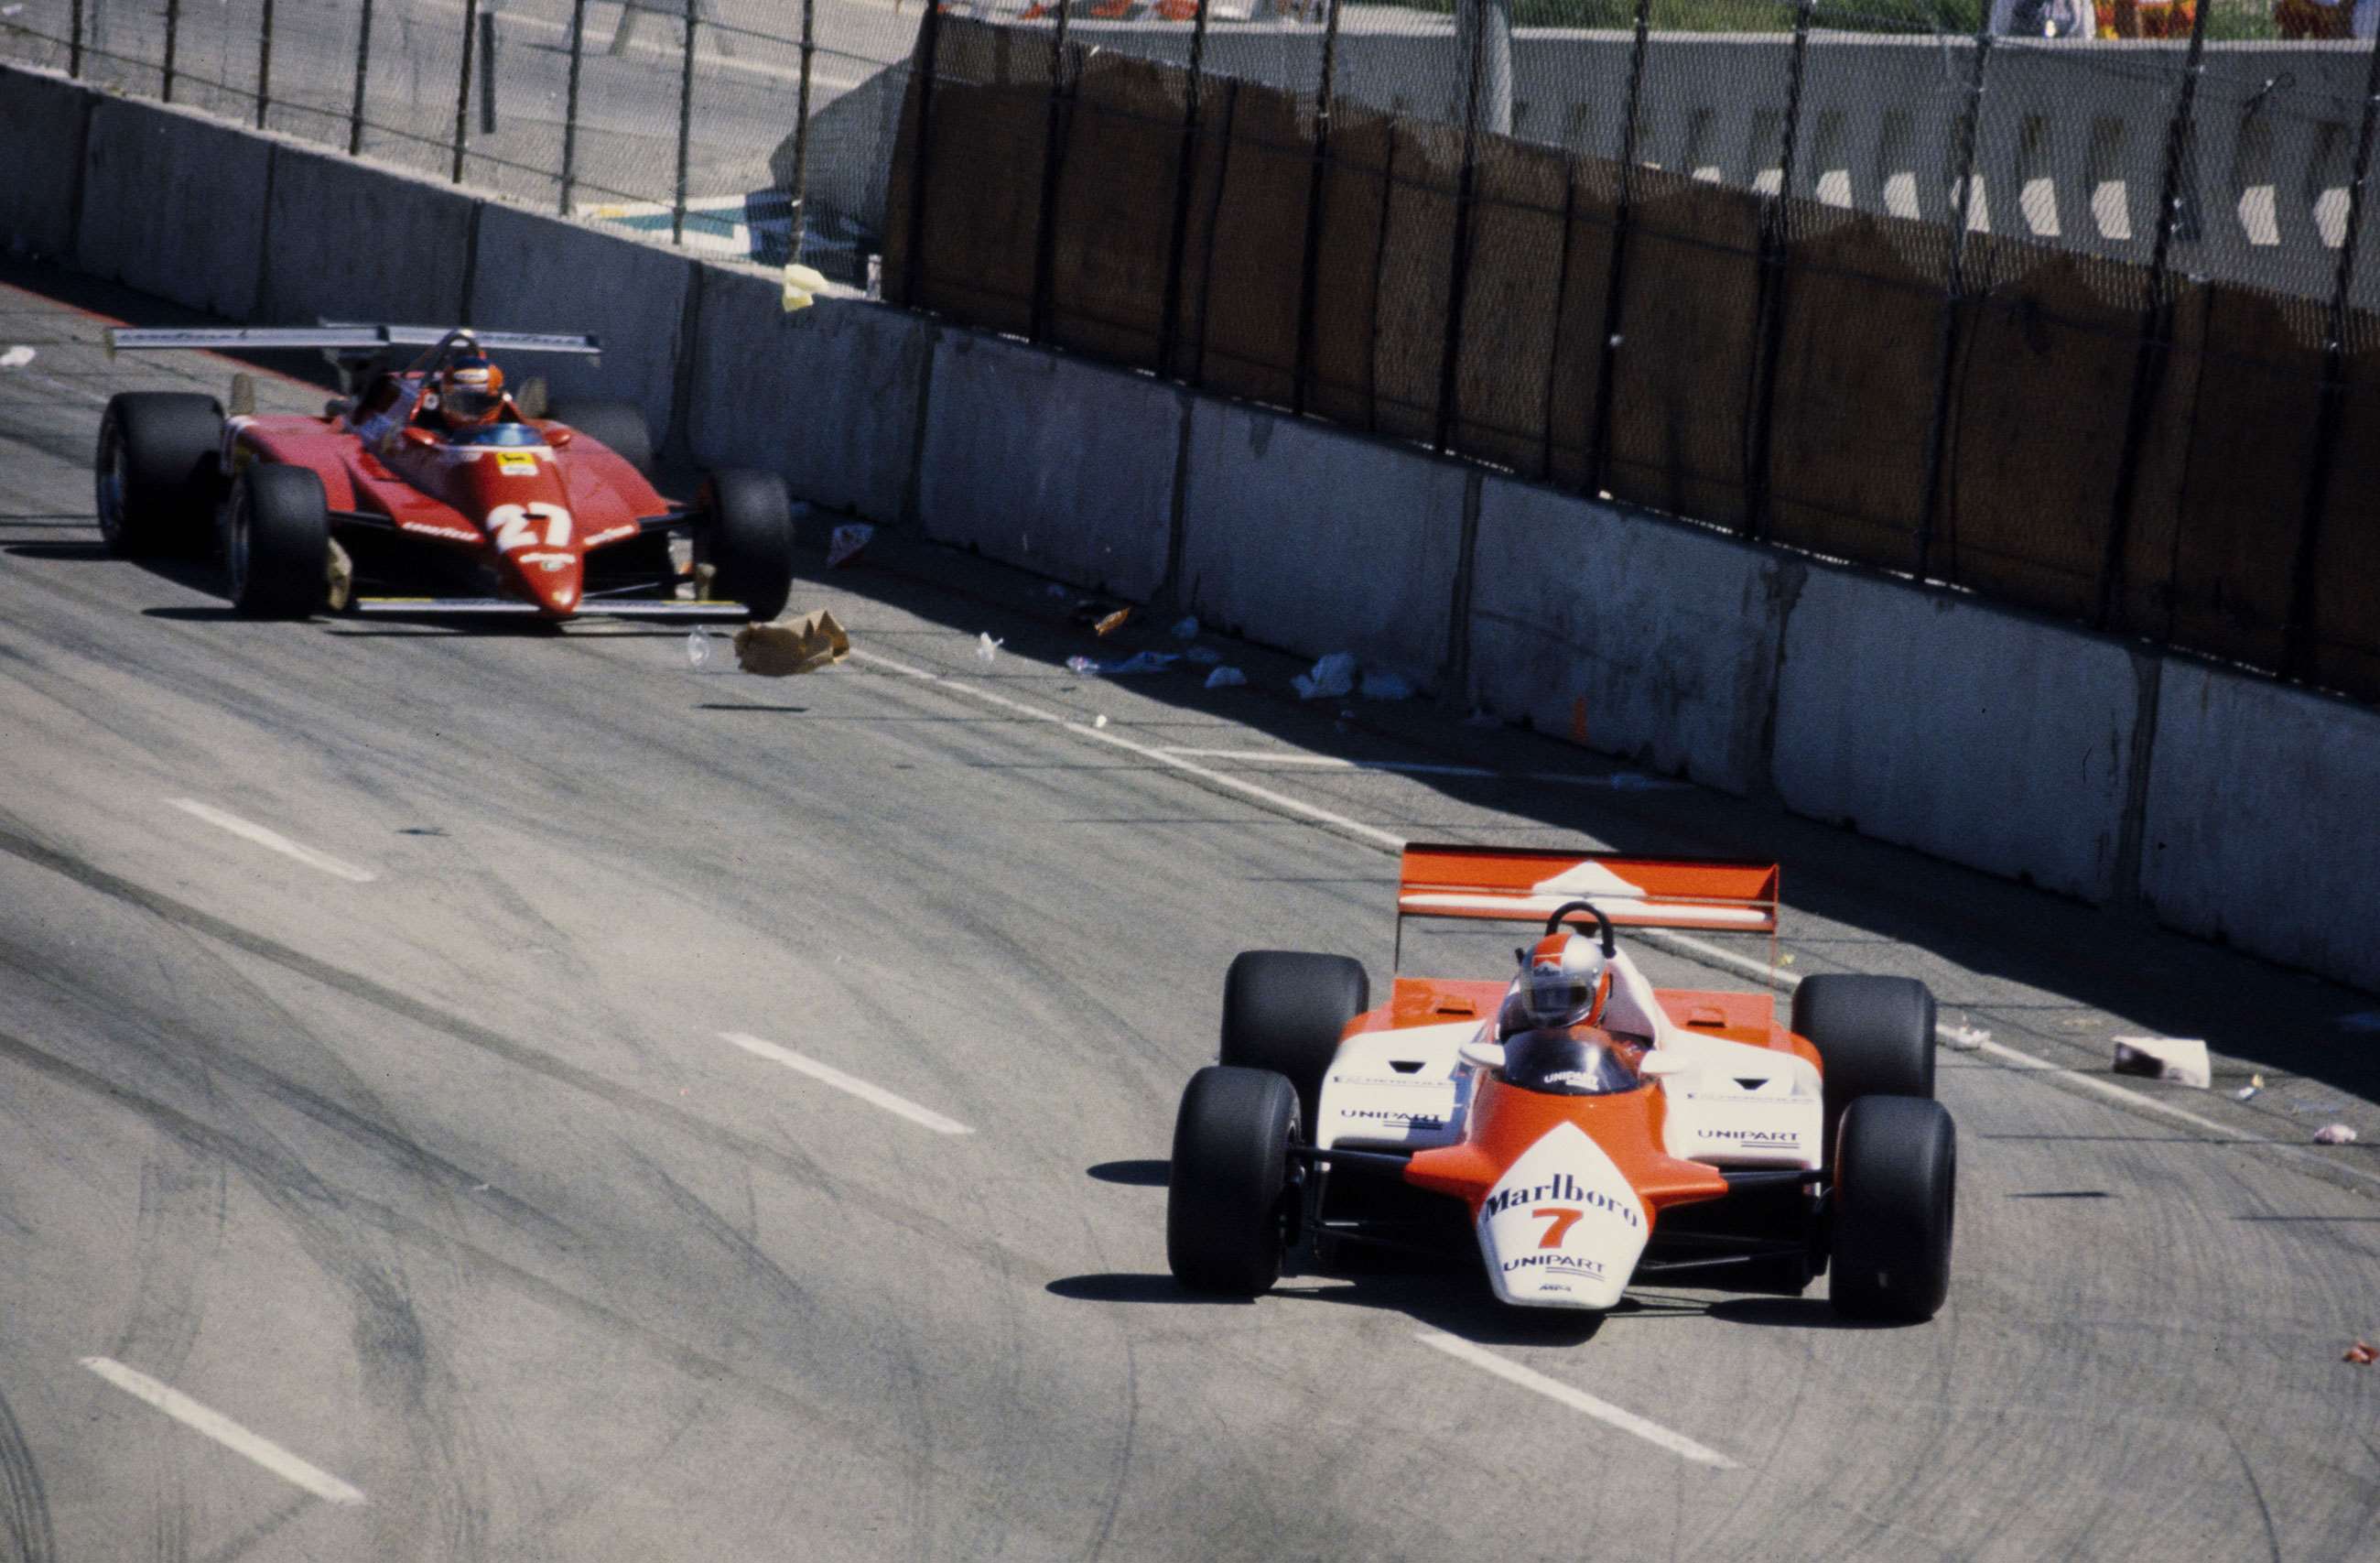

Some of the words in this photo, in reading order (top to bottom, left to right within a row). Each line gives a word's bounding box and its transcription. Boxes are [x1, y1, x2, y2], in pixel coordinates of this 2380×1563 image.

[487, 501, 572, 552] 27
[1341, 1109, 1441, 1123] UNIPART
[1698, 1129, 1801, 1142] UNIPART
[1485, 1173, 1638, 1228] Marlboro
[1531, 1207, 1584, 1249] 7
[1503, 1254, 1606, 1273] UNIPART
